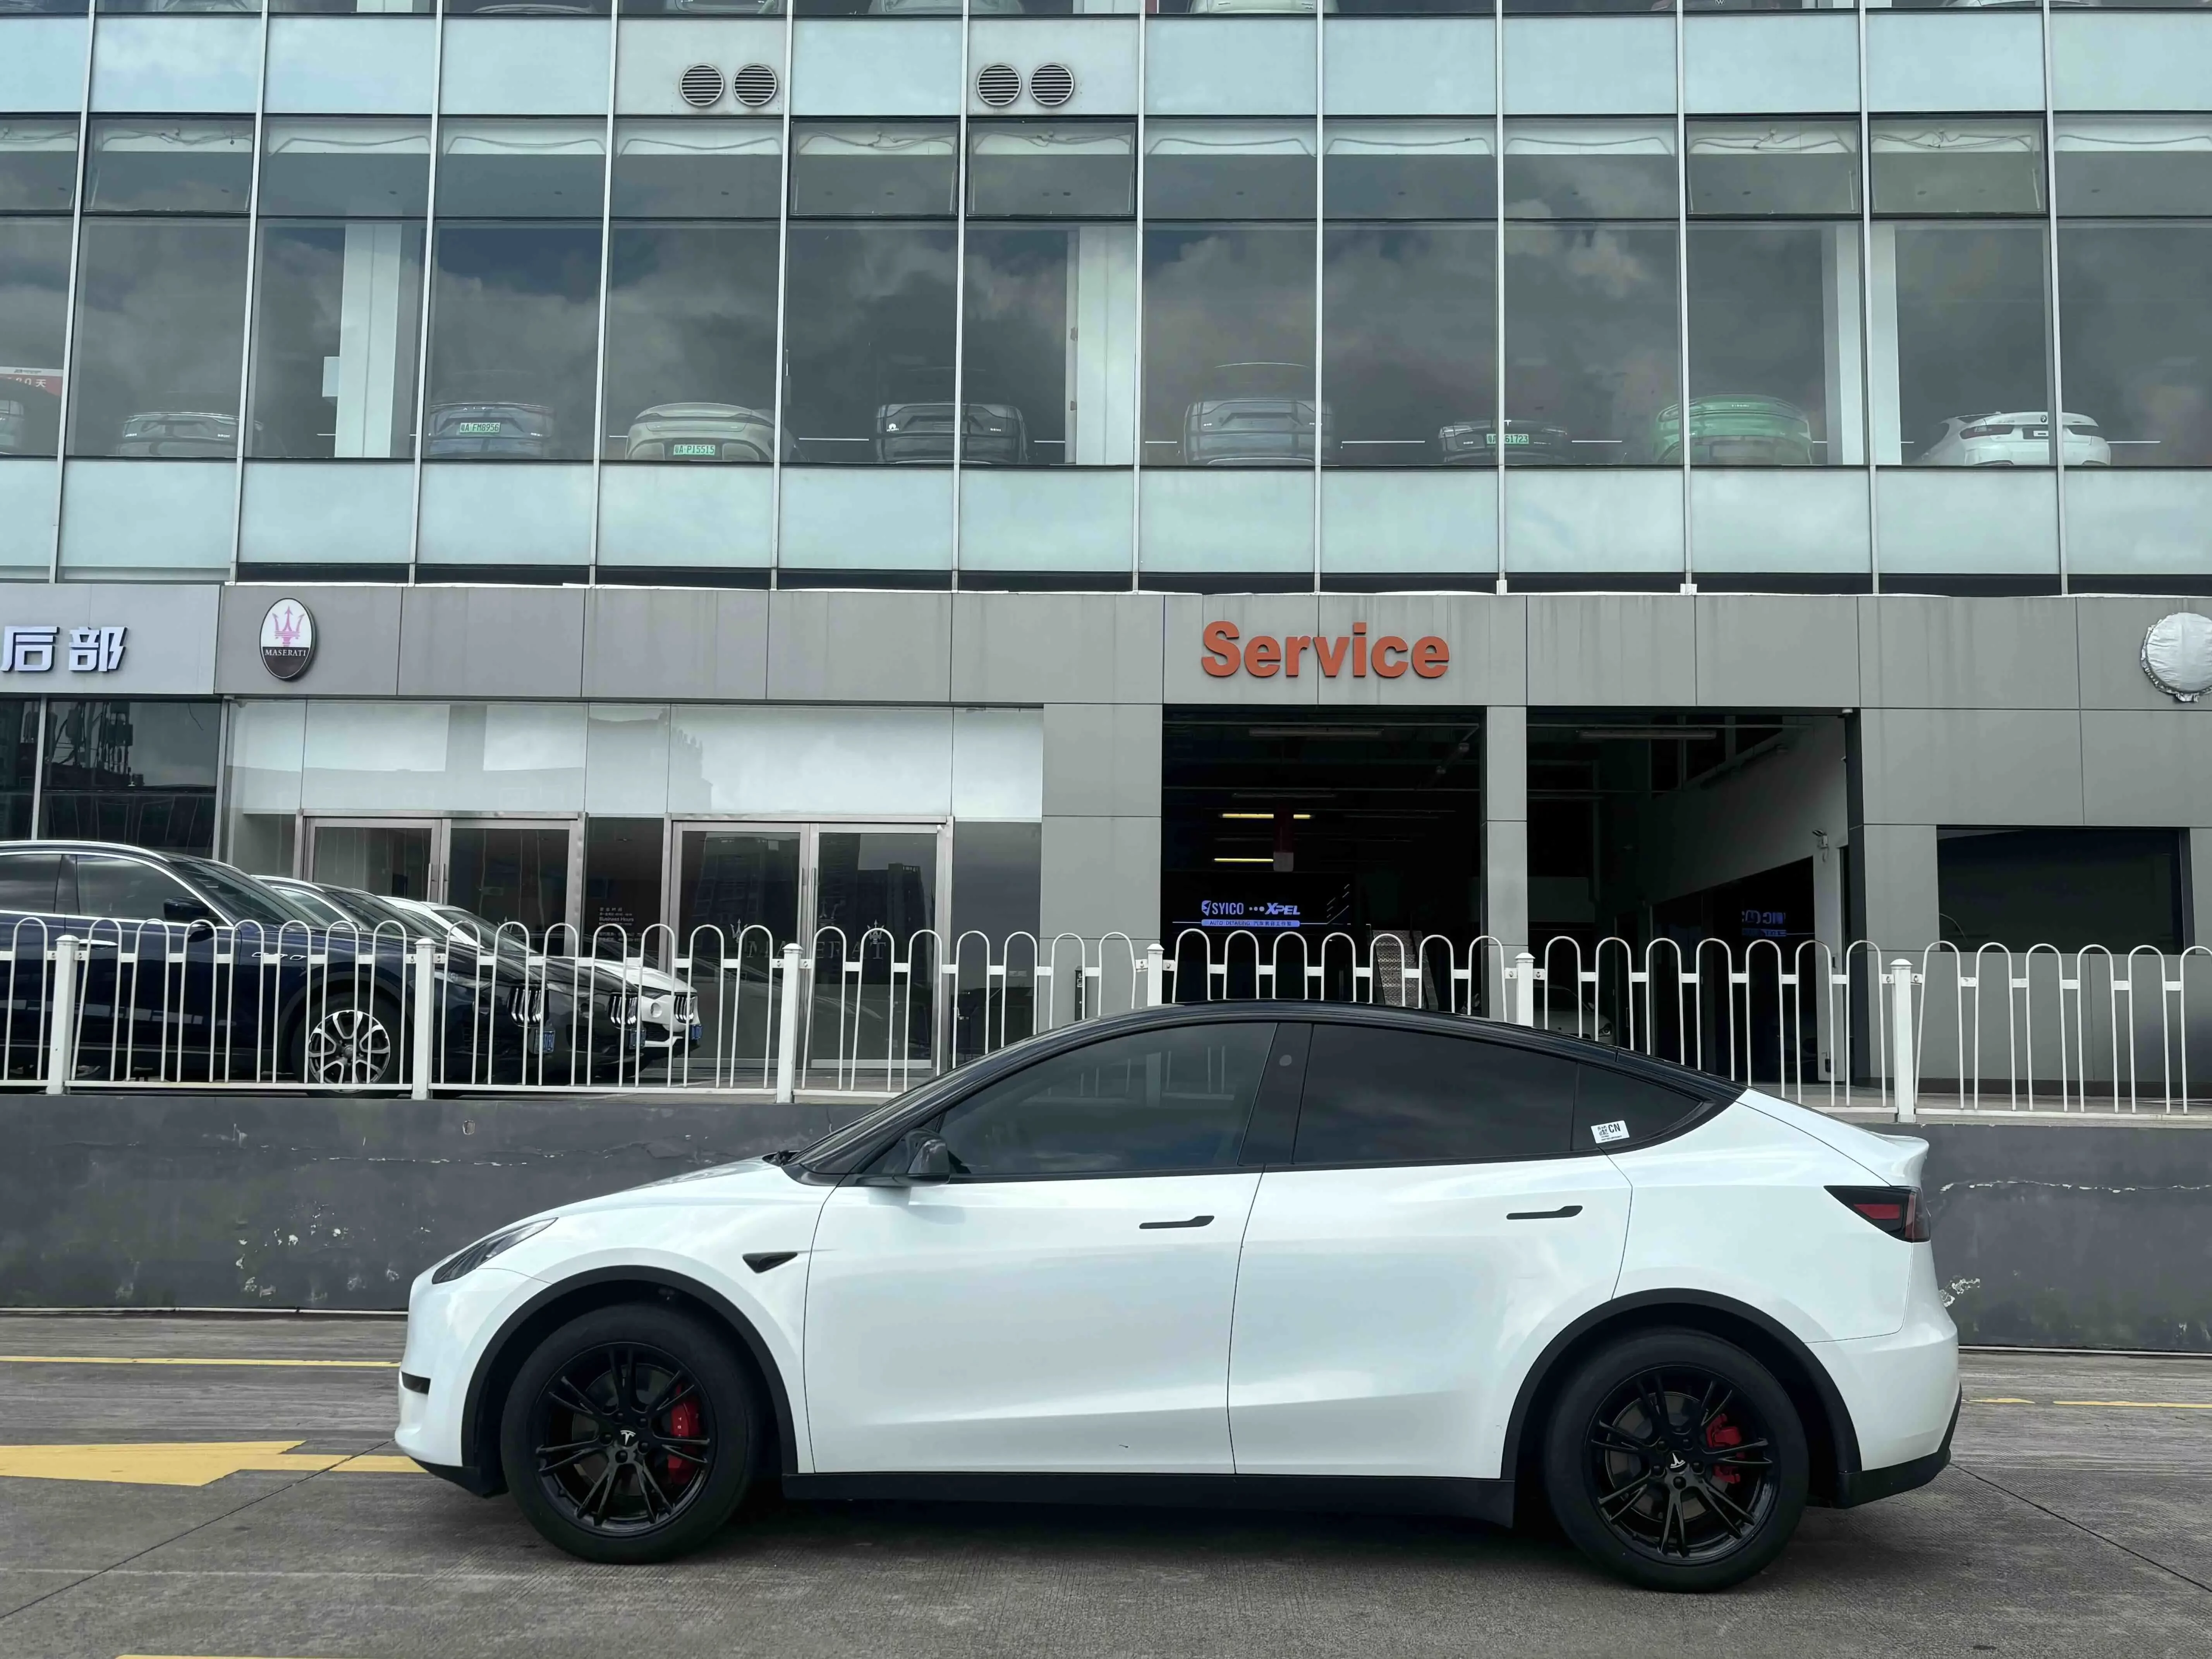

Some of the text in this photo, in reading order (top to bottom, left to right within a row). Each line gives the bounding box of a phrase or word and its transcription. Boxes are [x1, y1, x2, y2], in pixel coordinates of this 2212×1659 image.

[0, 626, 126, 672] 后部
[1201, 620, 1449, 677] Service
[1212, 902, 1300, 915] SYICO XPEL
[1608, 1123, 1621, 1133] CN
